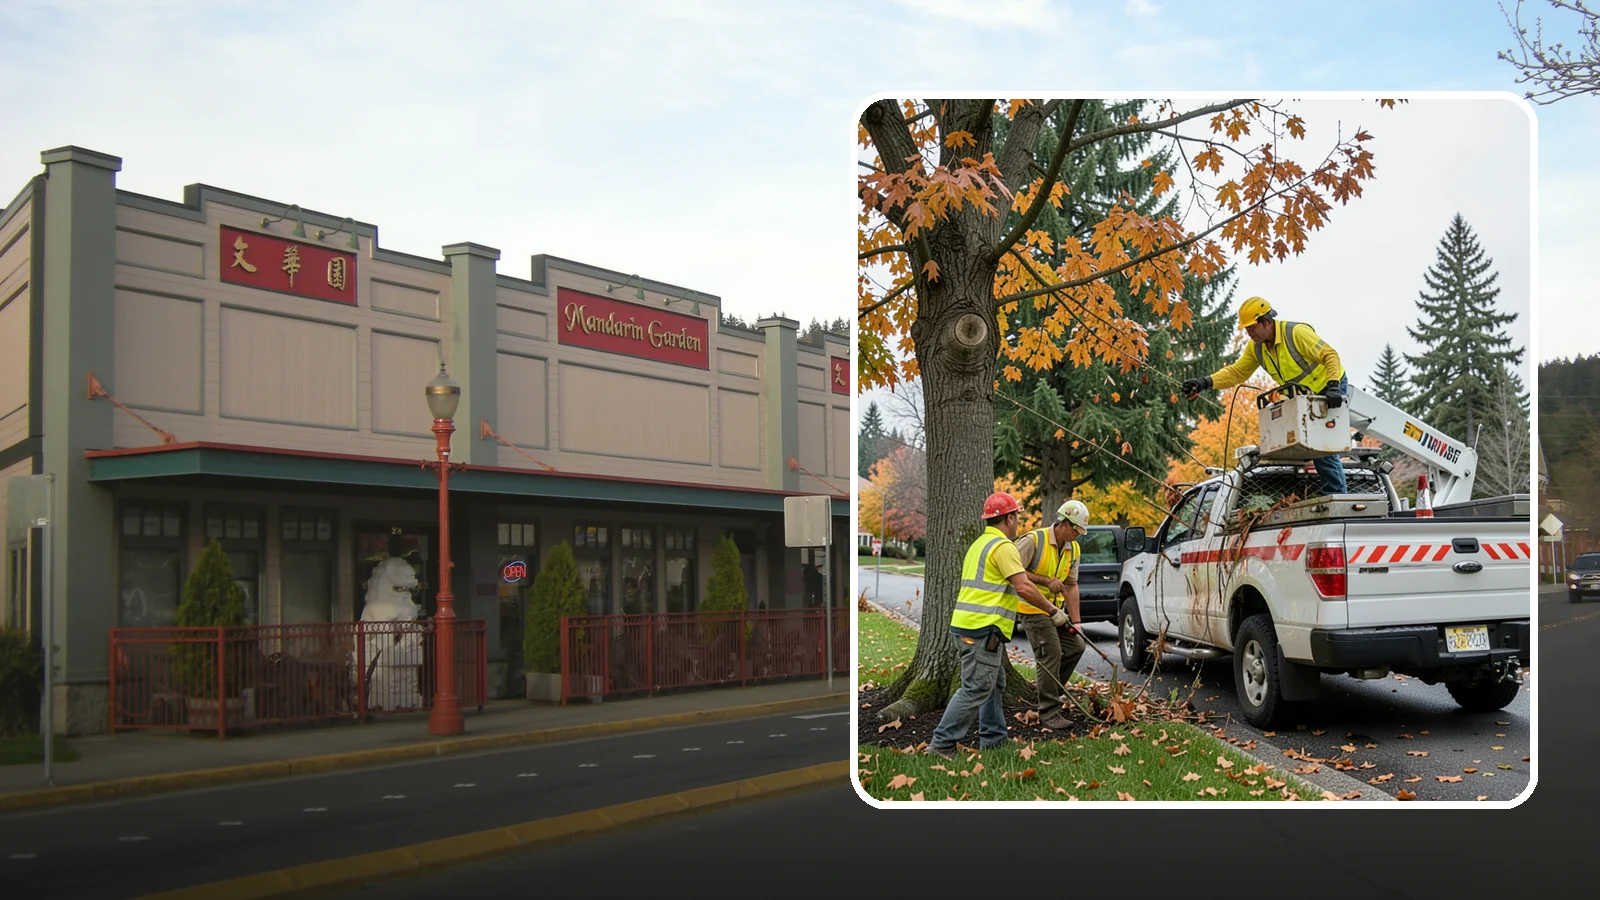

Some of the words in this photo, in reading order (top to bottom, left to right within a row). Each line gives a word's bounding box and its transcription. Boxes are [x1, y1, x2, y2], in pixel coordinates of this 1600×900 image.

[231, 236, 346, 291] 文華園
[564, 302, 644, 341] Mandarin
[647, 320, 701, 352] Garden
[503, 565, 527, 578] OPEN
